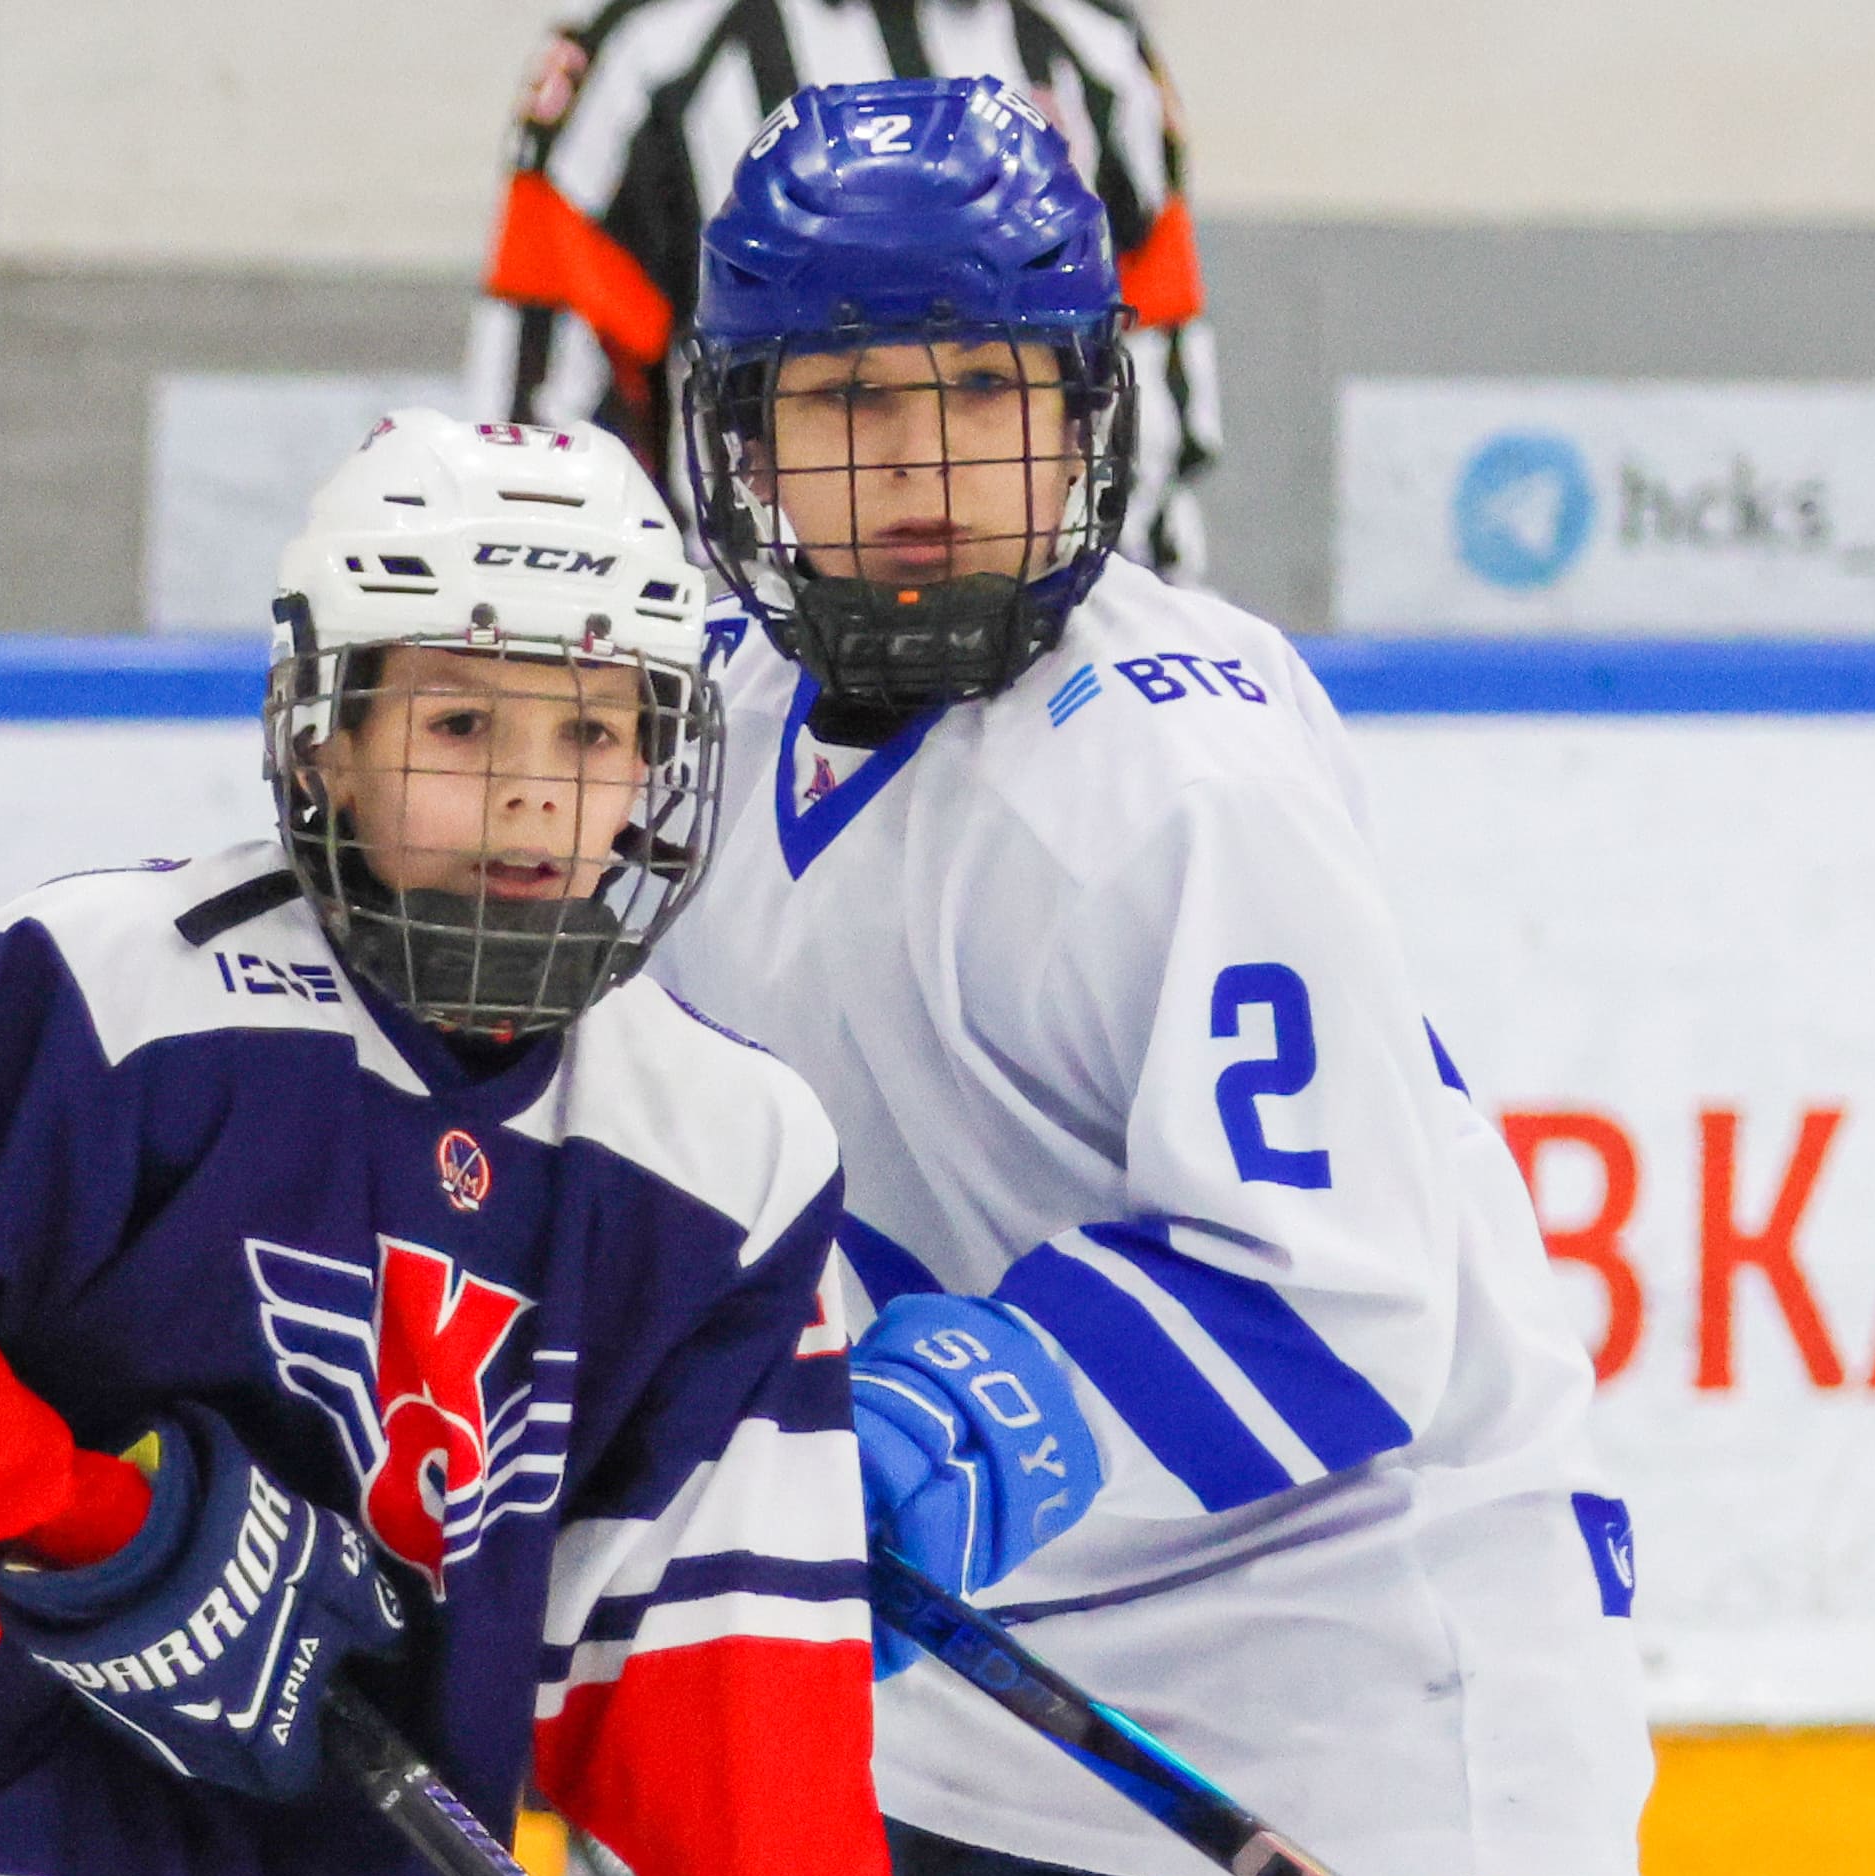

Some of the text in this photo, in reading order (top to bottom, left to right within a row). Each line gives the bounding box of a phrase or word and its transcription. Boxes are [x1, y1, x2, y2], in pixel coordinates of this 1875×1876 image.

[870, 114, 912, 153] 2
[474, 543, 617, 577] CCM
[1114, 652, 1268, 706] ВТБ
[1210, 962, 1332, 1190] 2
[271, 1637, 320, 1747] ALPHA
